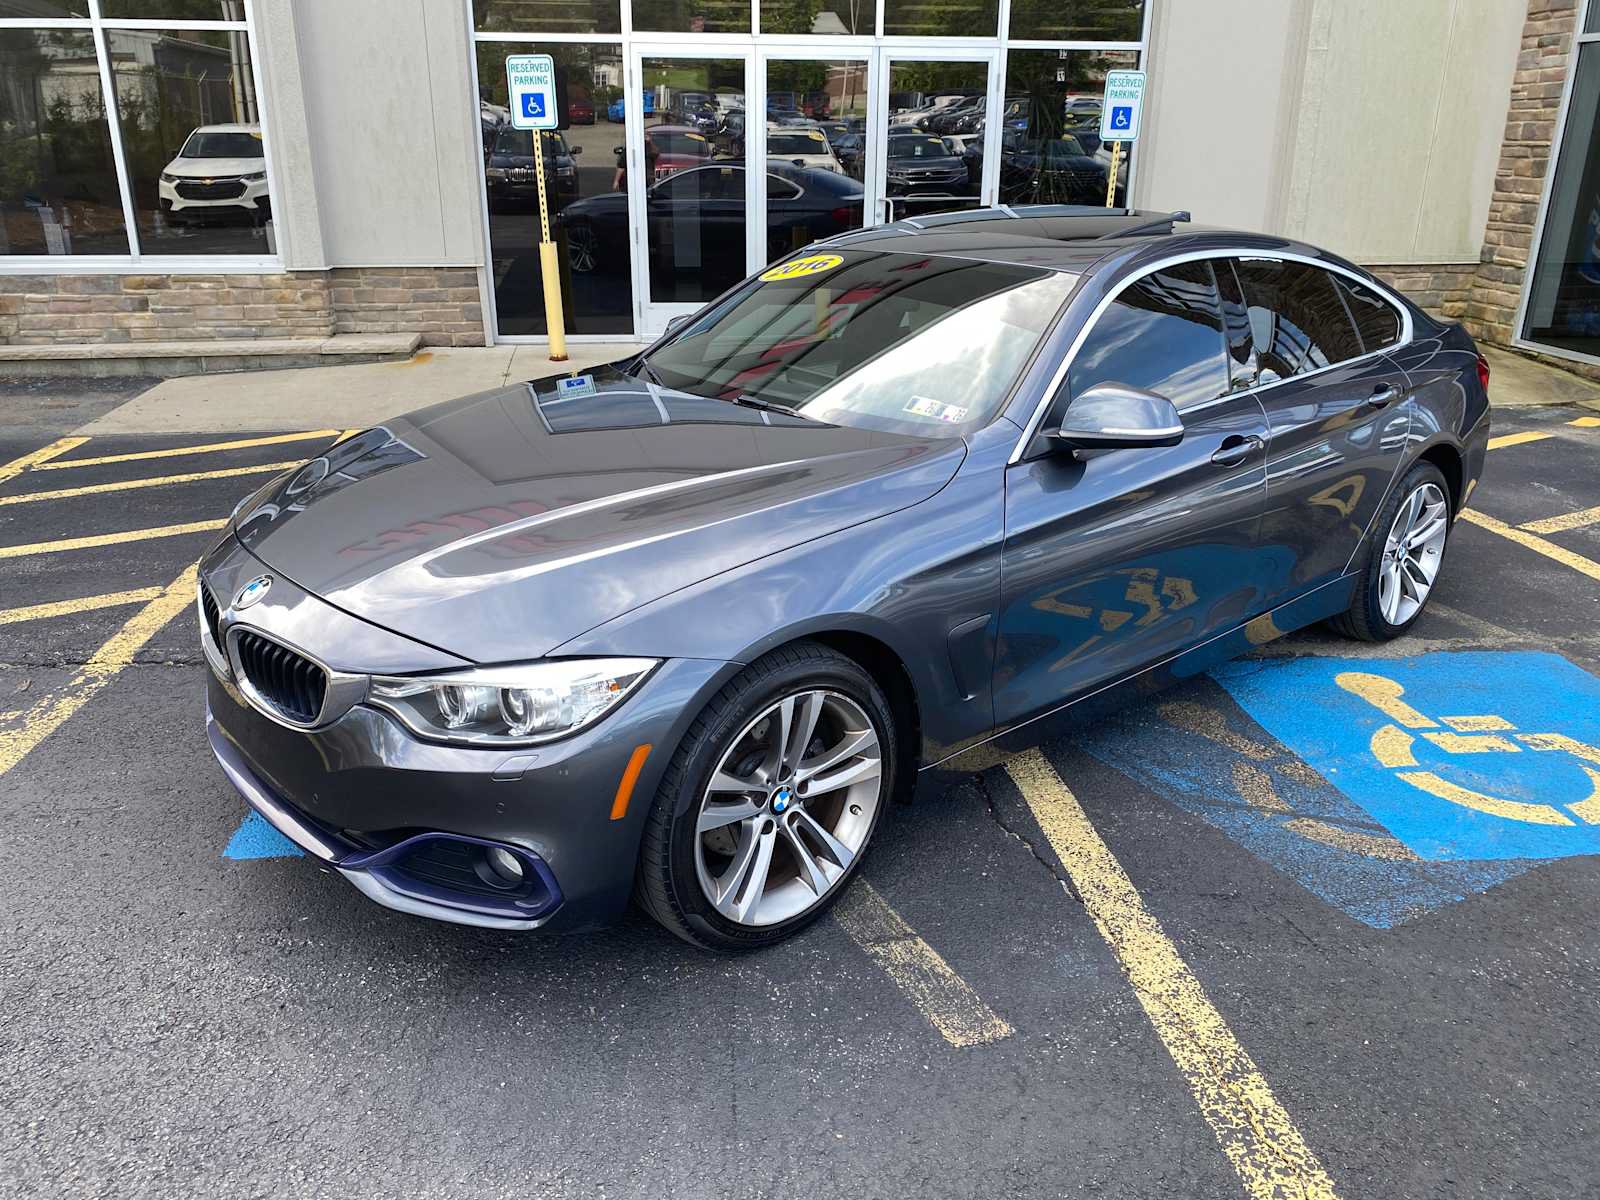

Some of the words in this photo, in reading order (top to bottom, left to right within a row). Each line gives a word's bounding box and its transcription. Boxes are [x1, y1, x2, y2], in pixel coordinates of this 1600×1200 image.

[510, 63, 550, 73] RESERVED
[514, 75, 549, 85] PARKING
[1109, 78, 1143, 88] RESERVED
[1109, 89, 1140, 99] PARKING
